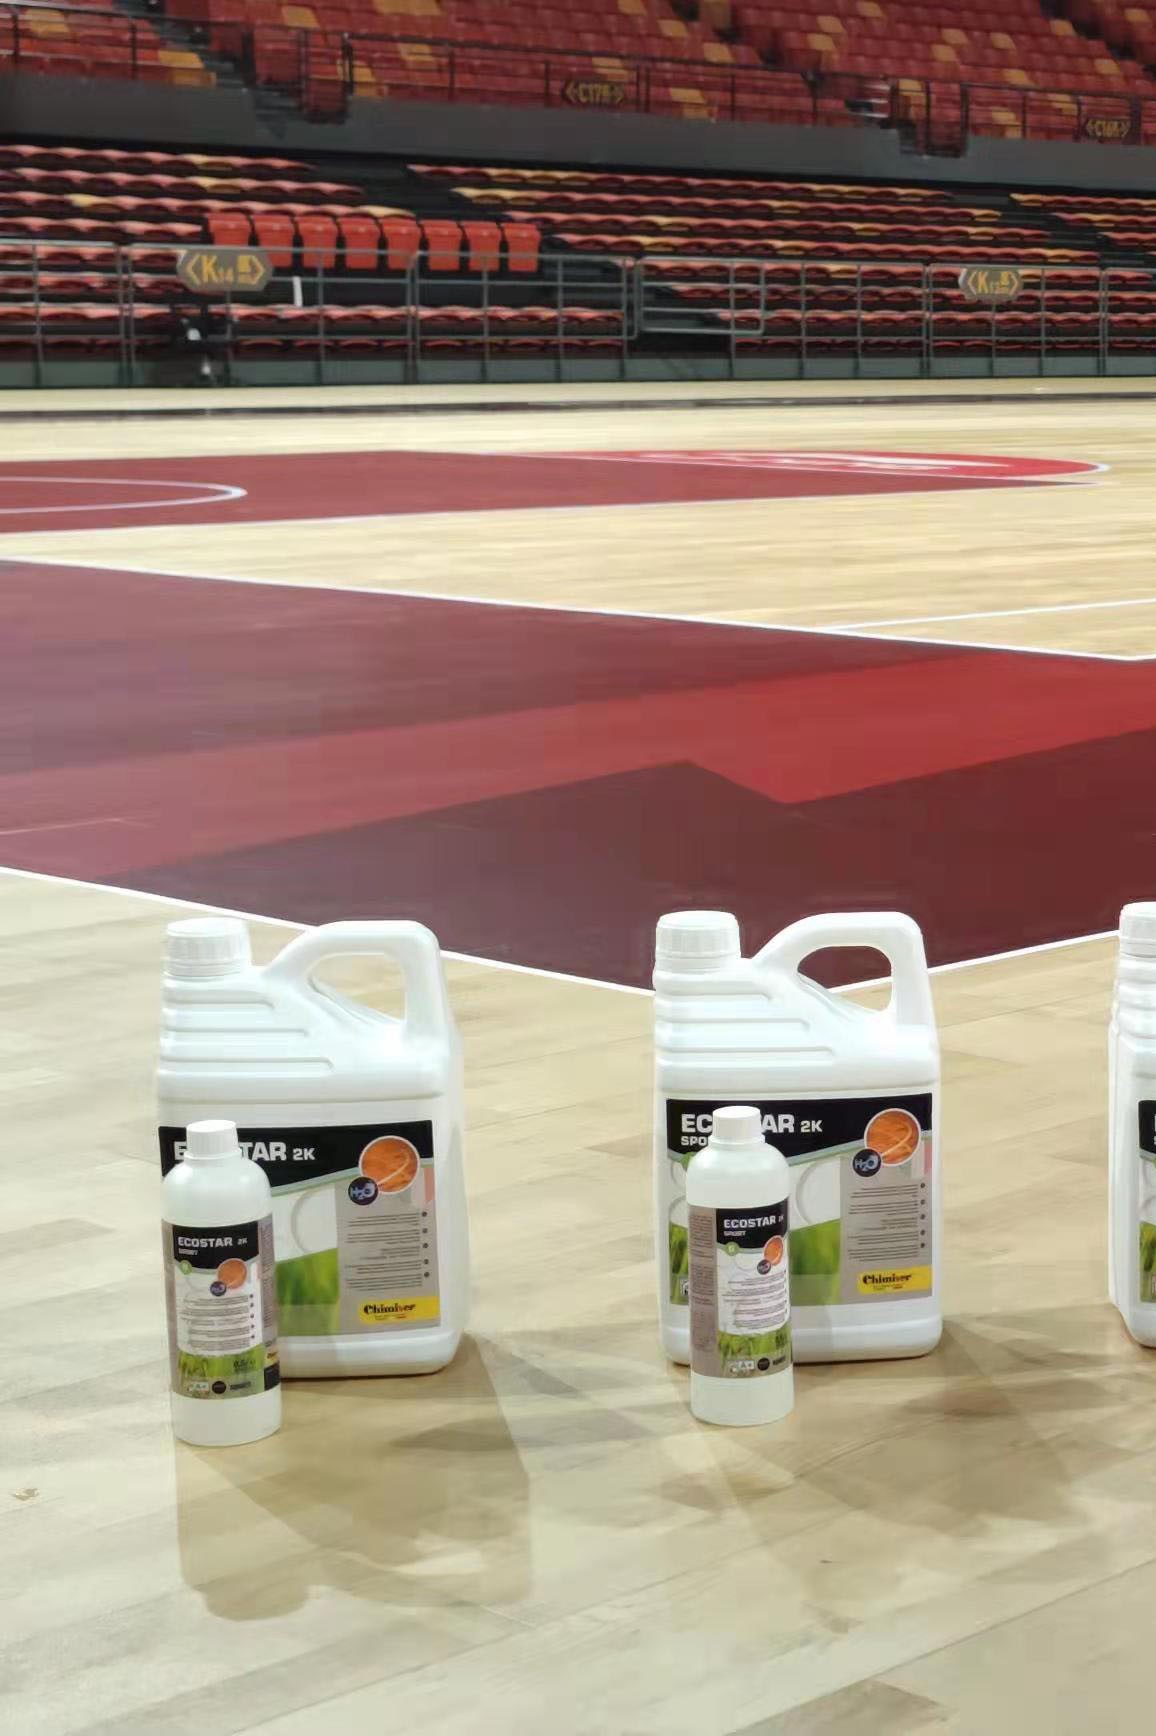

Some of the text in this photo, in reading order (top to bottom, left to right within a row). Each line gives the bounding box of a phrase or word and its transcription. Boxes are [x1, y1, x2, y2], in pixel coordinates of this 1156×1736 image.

[800, 1120, 823, 1133] 2K
[681, 1135, 709, 1147] SPO
[292, 1148, 316, 1161] 2K
[723, 1215, 777, 1229] ECOSTAR
[177, 1236, 234, 1248] ECOSTAR
[863, 1273, 913, 1285] Chimiver
